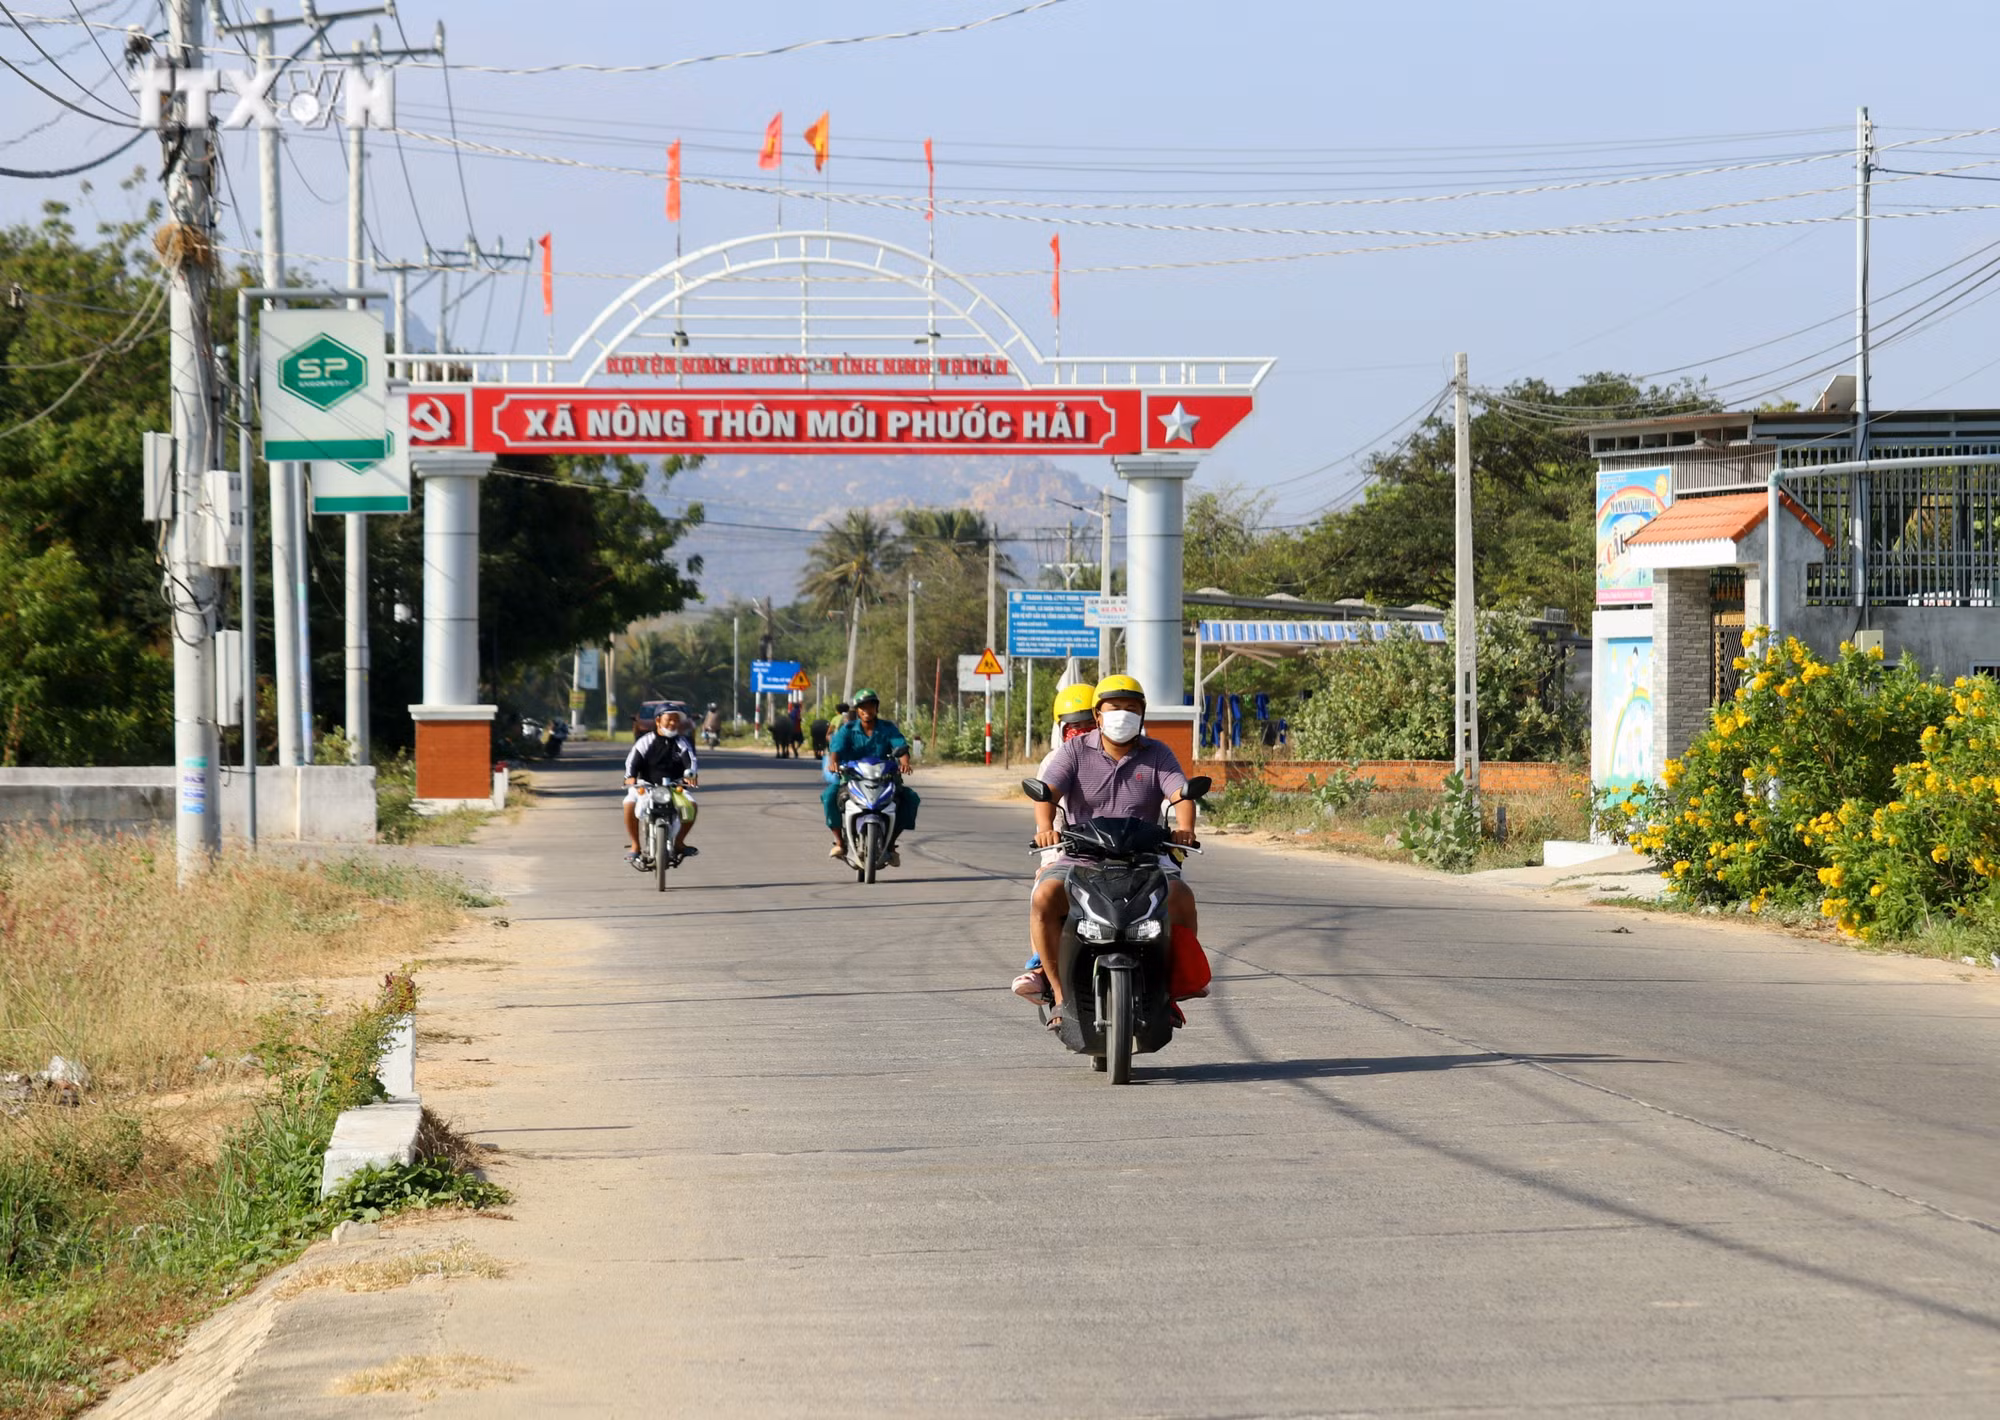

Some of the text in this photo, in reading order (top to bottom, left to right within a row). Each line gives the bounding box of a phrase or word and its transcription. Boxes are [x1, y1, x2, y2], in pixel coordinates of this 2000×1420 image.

[297, 357, 349, 379] SP
[524, 401, 1087, 439] XÃ NÔNG THÔN MỚI PHƯỚC HẢI
